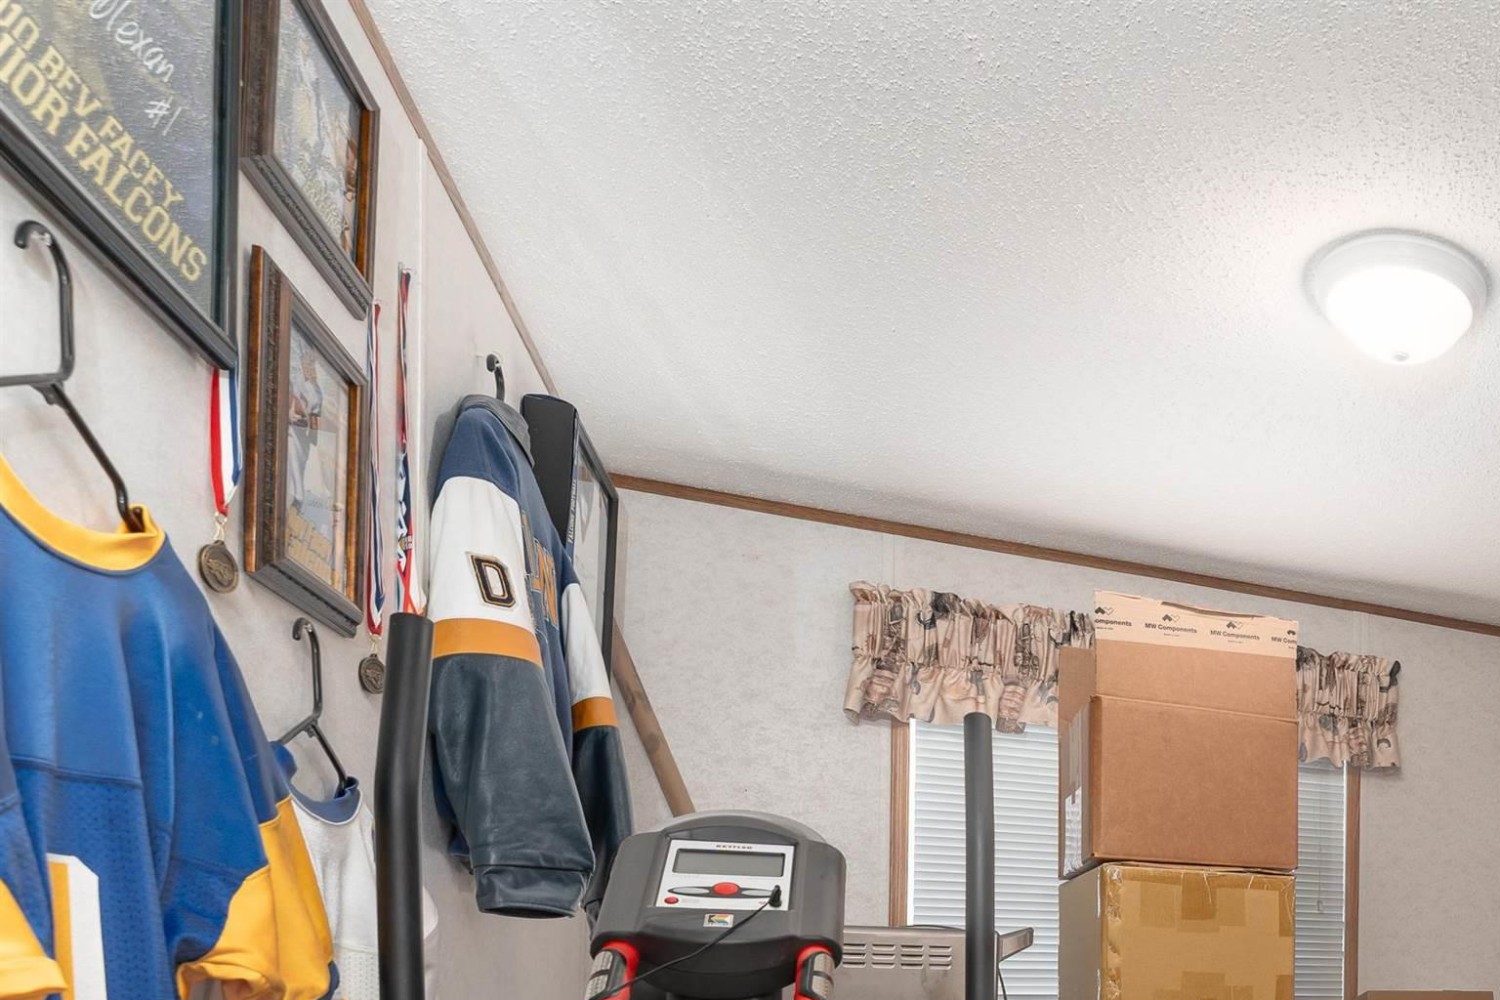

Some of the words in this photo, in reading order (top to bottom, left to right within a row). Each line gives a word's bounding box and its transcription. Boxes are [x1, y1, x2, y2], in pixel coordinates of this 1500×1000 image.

[144, 96, 184, 137] #1
[64, 122, 208, 281] FALCONS
[1095, 618, 1132, 627] omponents
[1158, 624, 1198, 634] Components
[1222, 631, 1260, 641] Components
